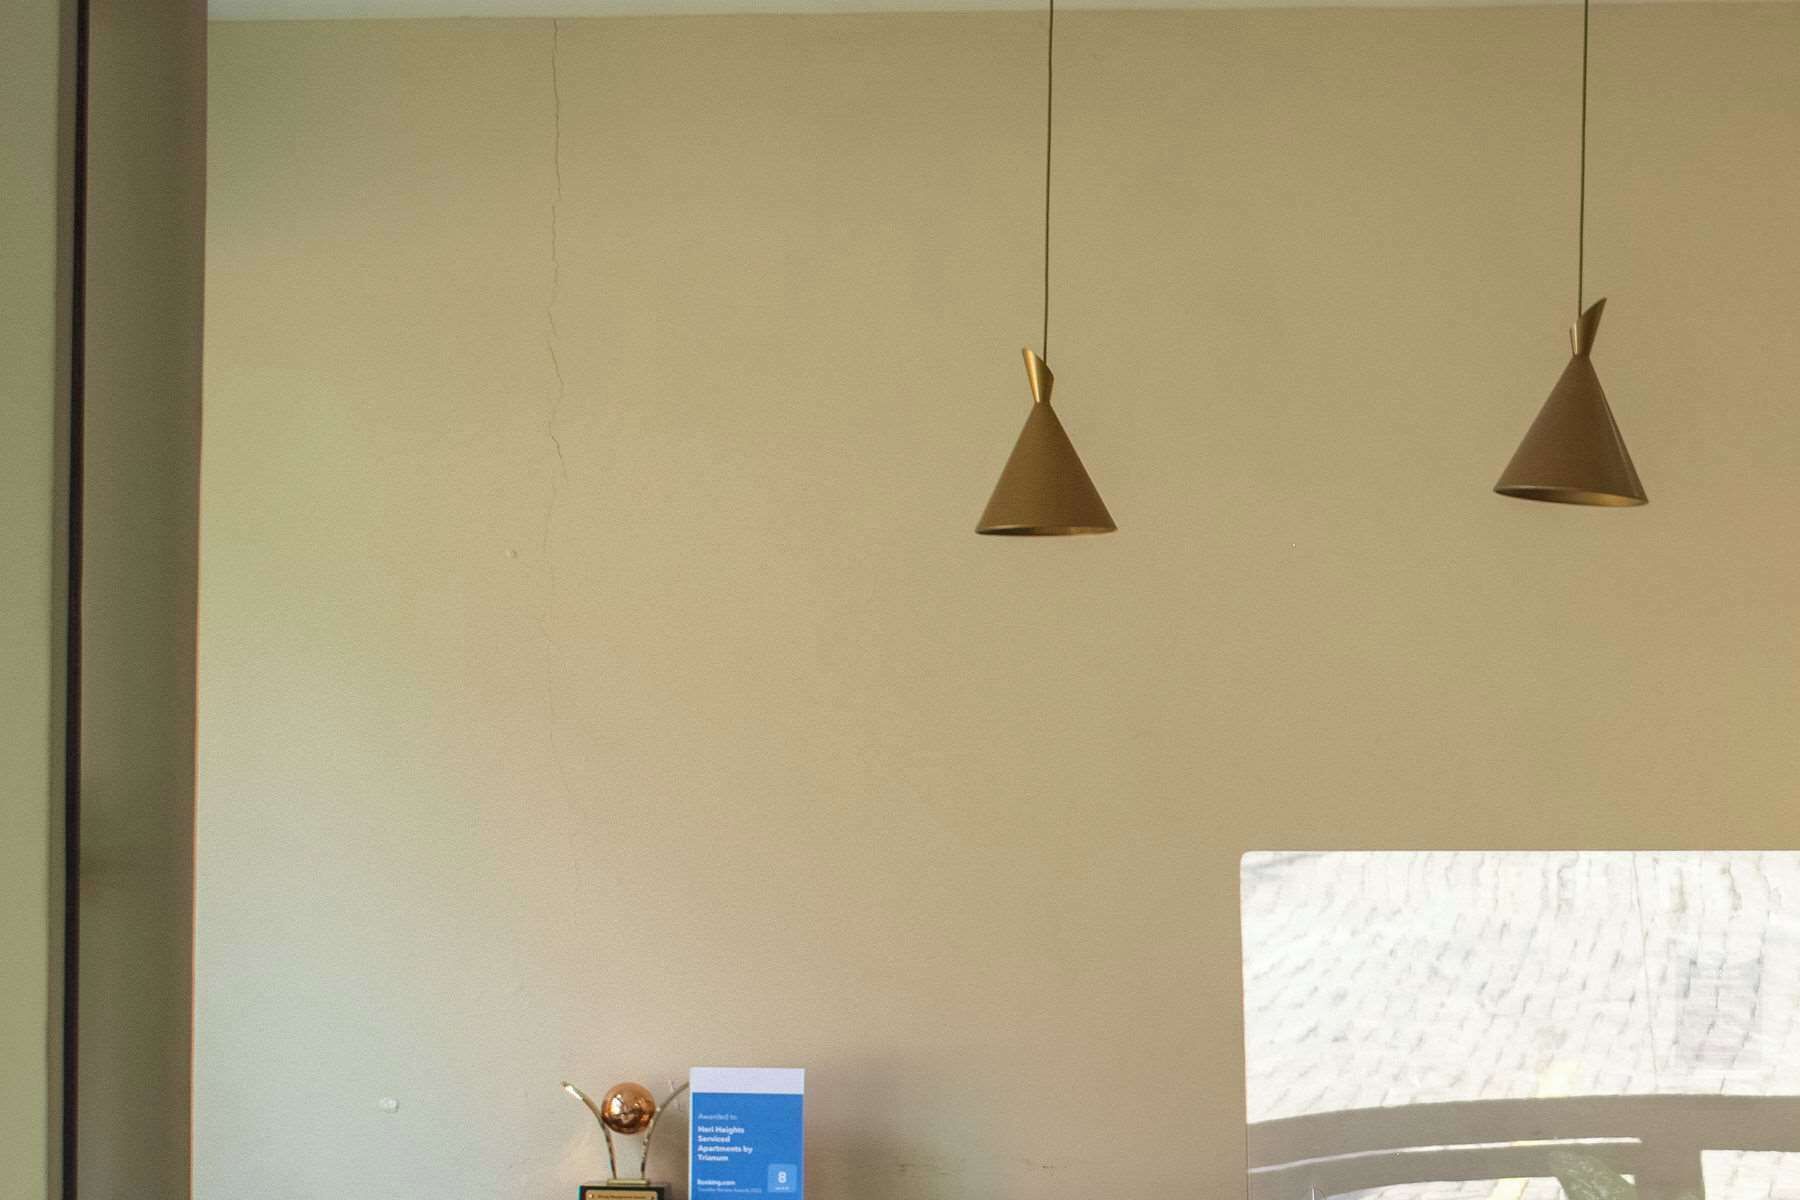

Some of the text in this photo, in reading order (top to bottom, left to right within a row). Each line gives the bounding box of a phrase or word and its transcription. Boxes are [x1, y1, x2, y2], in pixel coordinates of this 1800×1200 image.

[715, 1126, 745, 1135] Heights
[698, 1135, 731, 1143] Serviced
[698, 1145, 753, 1155] Apartments by
[777, 1171, 787, 1184] 8
